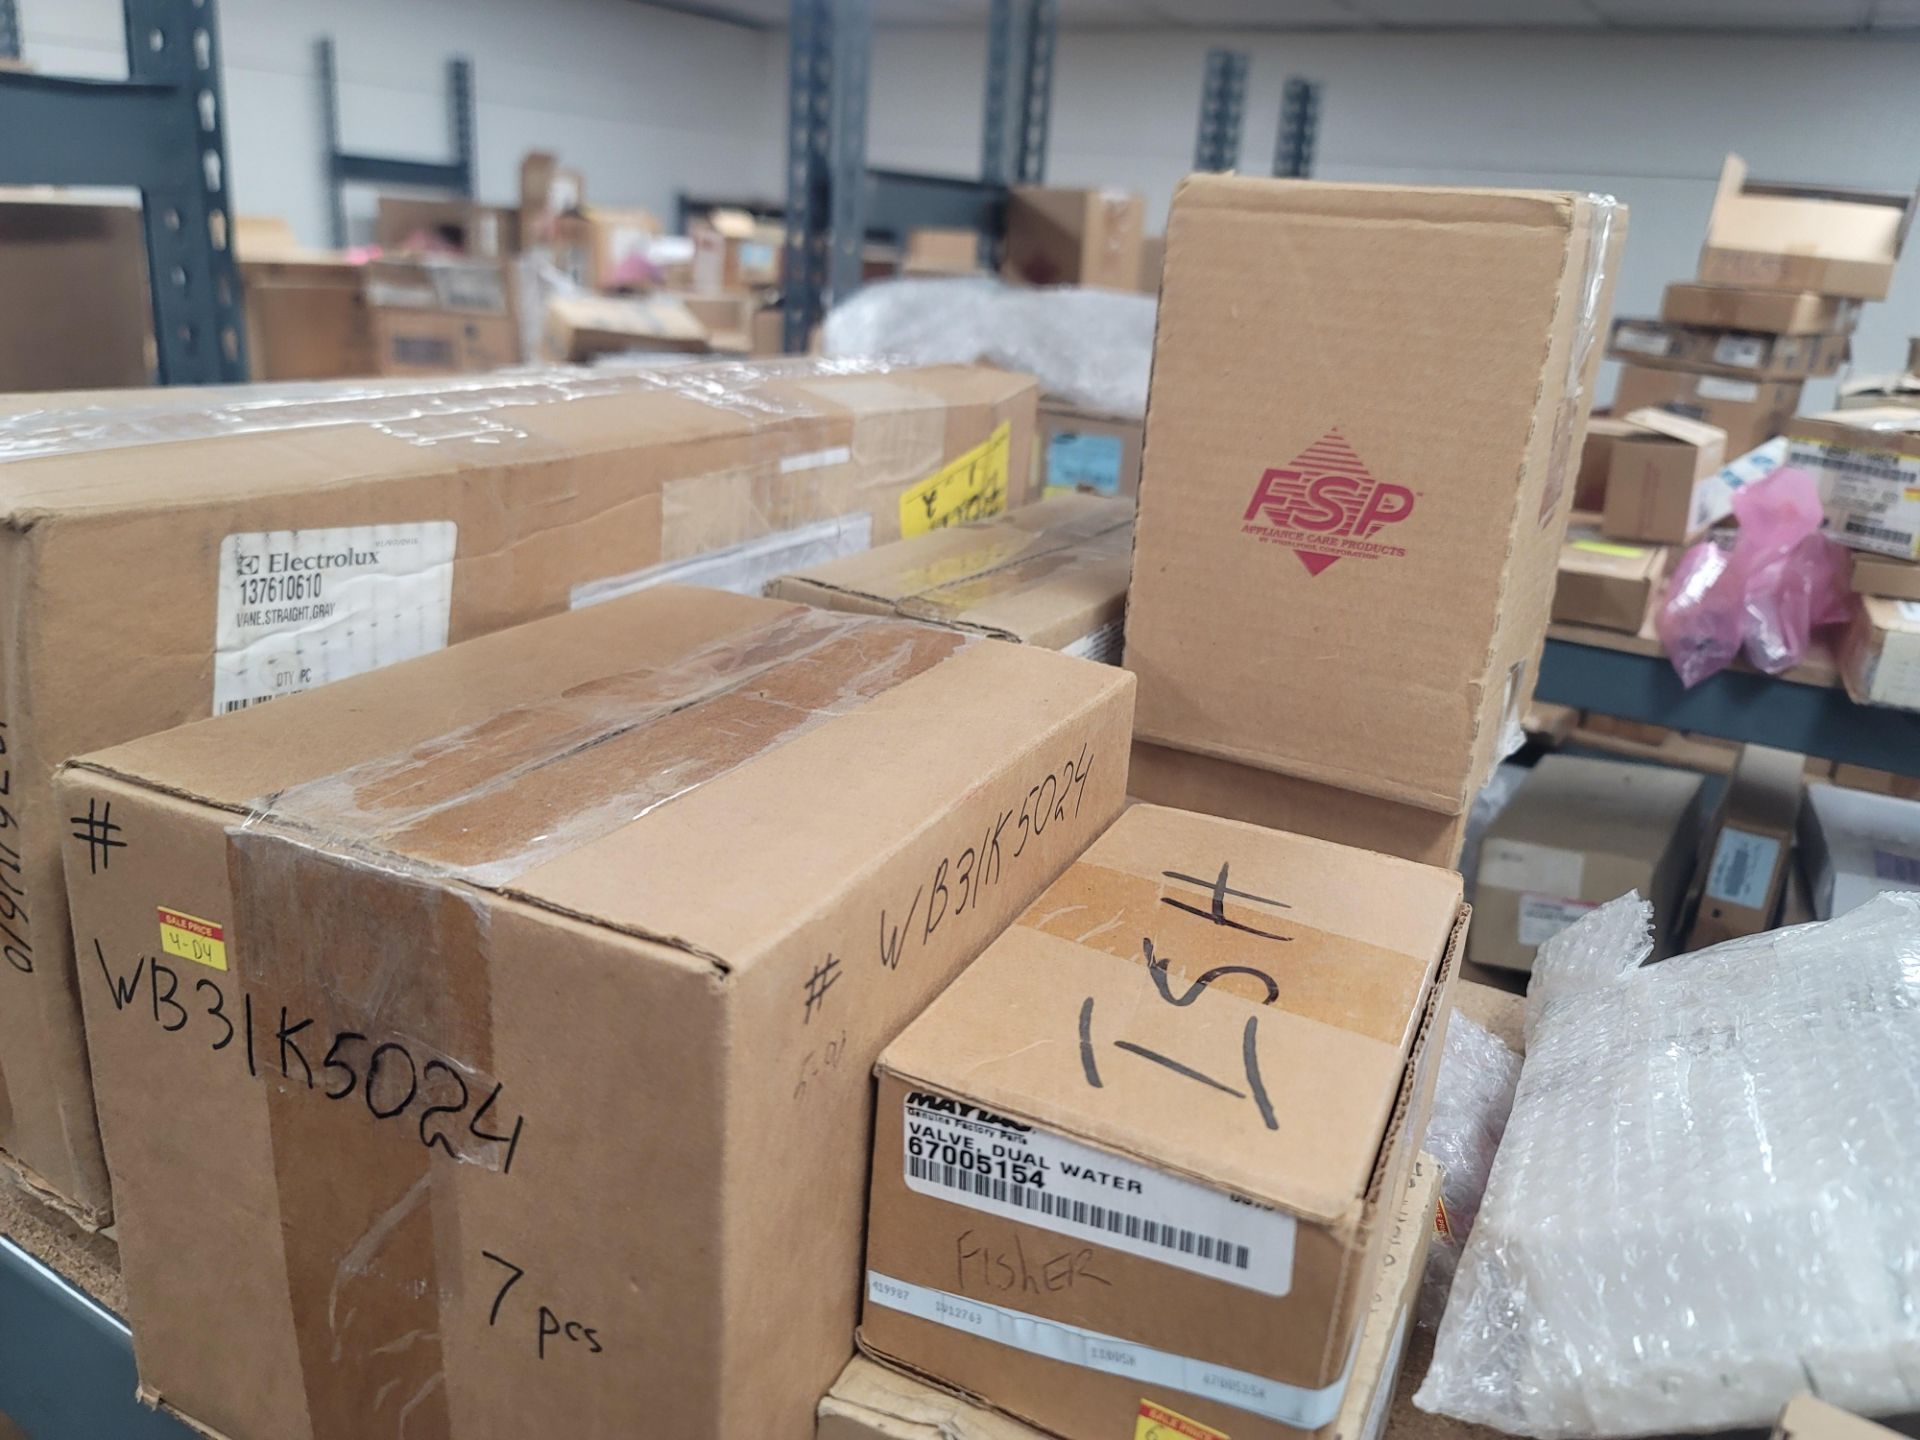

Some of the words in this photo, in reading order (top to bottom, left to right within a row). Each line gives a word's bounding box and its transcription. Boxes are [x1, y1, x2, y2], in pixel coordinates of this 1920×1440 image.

[1243, 469, 1415, 535] FSP
[268, 547, 380, 573] Electrolux
[1241, 525, 1304, 541] APPLIANCE
[1306, 532, 1339, 546] CARE
[1341, 538, 1407, 557] PRODUCTS
[240, 572, 322, 605] 137610610
[880, 742, 1095, 971] WB31K5024
[165, 914, 187, 929] SALE
[188, 921, 213, 937] PRICE
[94, 938, 524, 1174] WB31K5024
[908, 1107, 950, 1126] Genuine
[954, 1118, 994, 1138] Factory
[1000, 1130, 1028, 1145] Parts
[908, 1136, 1046, 1188] 67005154
[992, 1144, 1051, 1170] DUAL
[1060, 1161, 1143, 1195] WATER
[482, 1250, 524, 1326] 7
[538, 1306, 602, 1360] pcs
